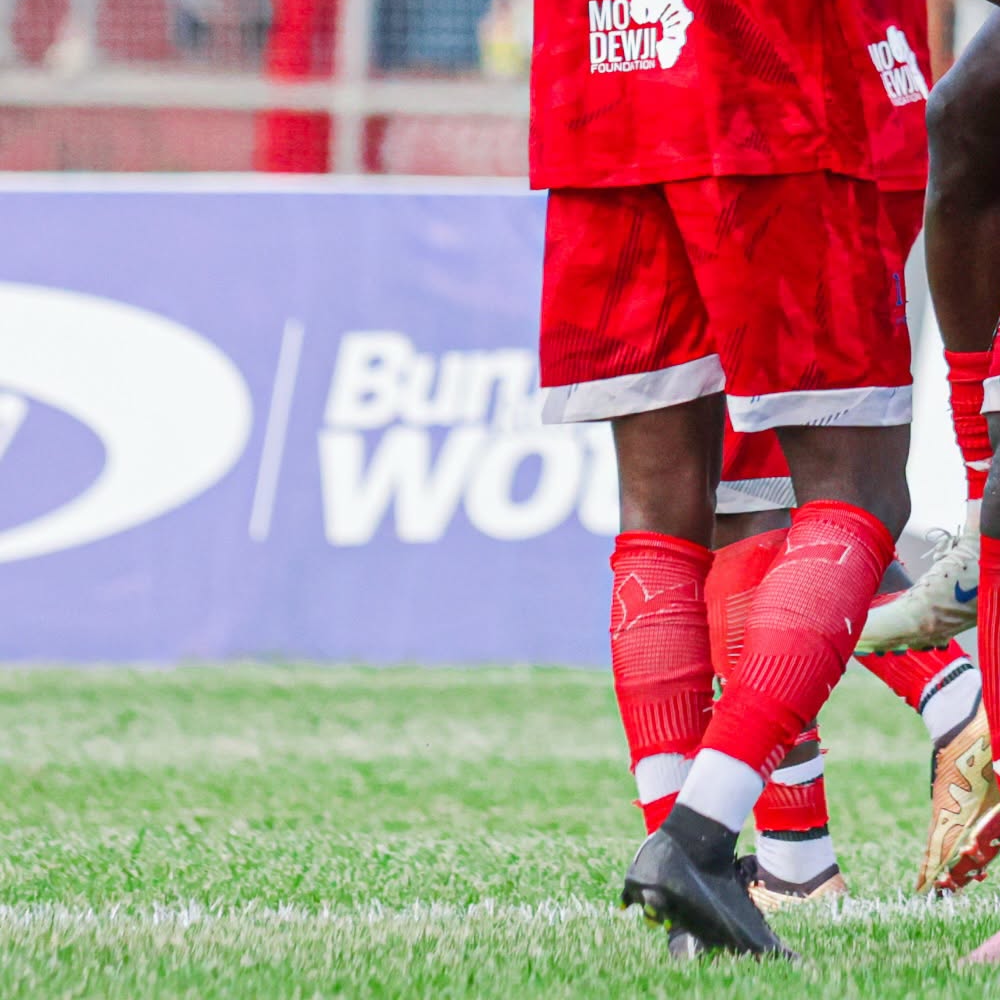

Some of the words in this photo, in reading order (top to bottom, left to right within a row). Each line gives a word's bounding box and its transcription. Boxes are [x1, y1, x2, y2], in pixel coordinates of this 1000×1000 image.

[589, 27, 657, 64] DEWJI
[590, 60, 656, 75] FOUNDATION
[322, 330, 545, 430] Bun
